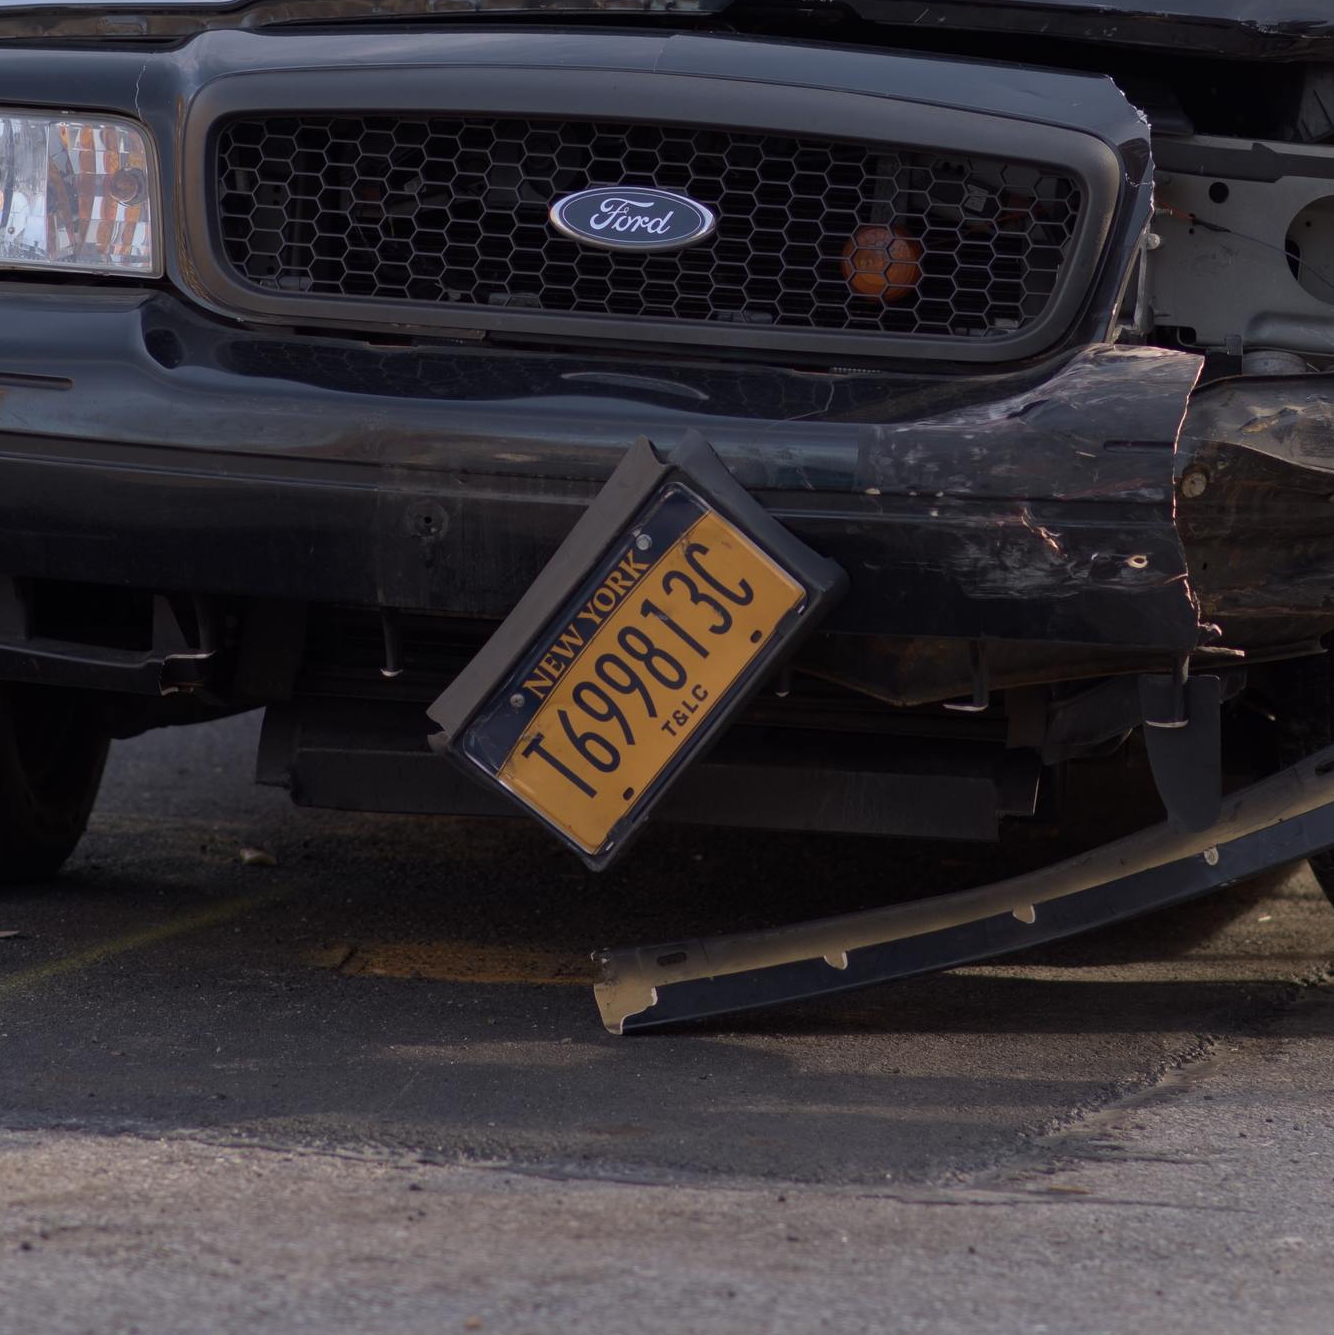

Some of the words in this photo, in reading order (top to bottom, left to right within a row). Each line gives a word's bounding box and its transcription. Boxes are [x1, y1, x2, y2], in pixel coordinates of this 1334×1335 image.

[589, 197, 675, 235] Ford
[522, 623, 585, 699] NEW
[576, 549, 651, 625] YORK
[522, 542, 755, 799] T699813C
[660, 683, 710, 738] T&LC
